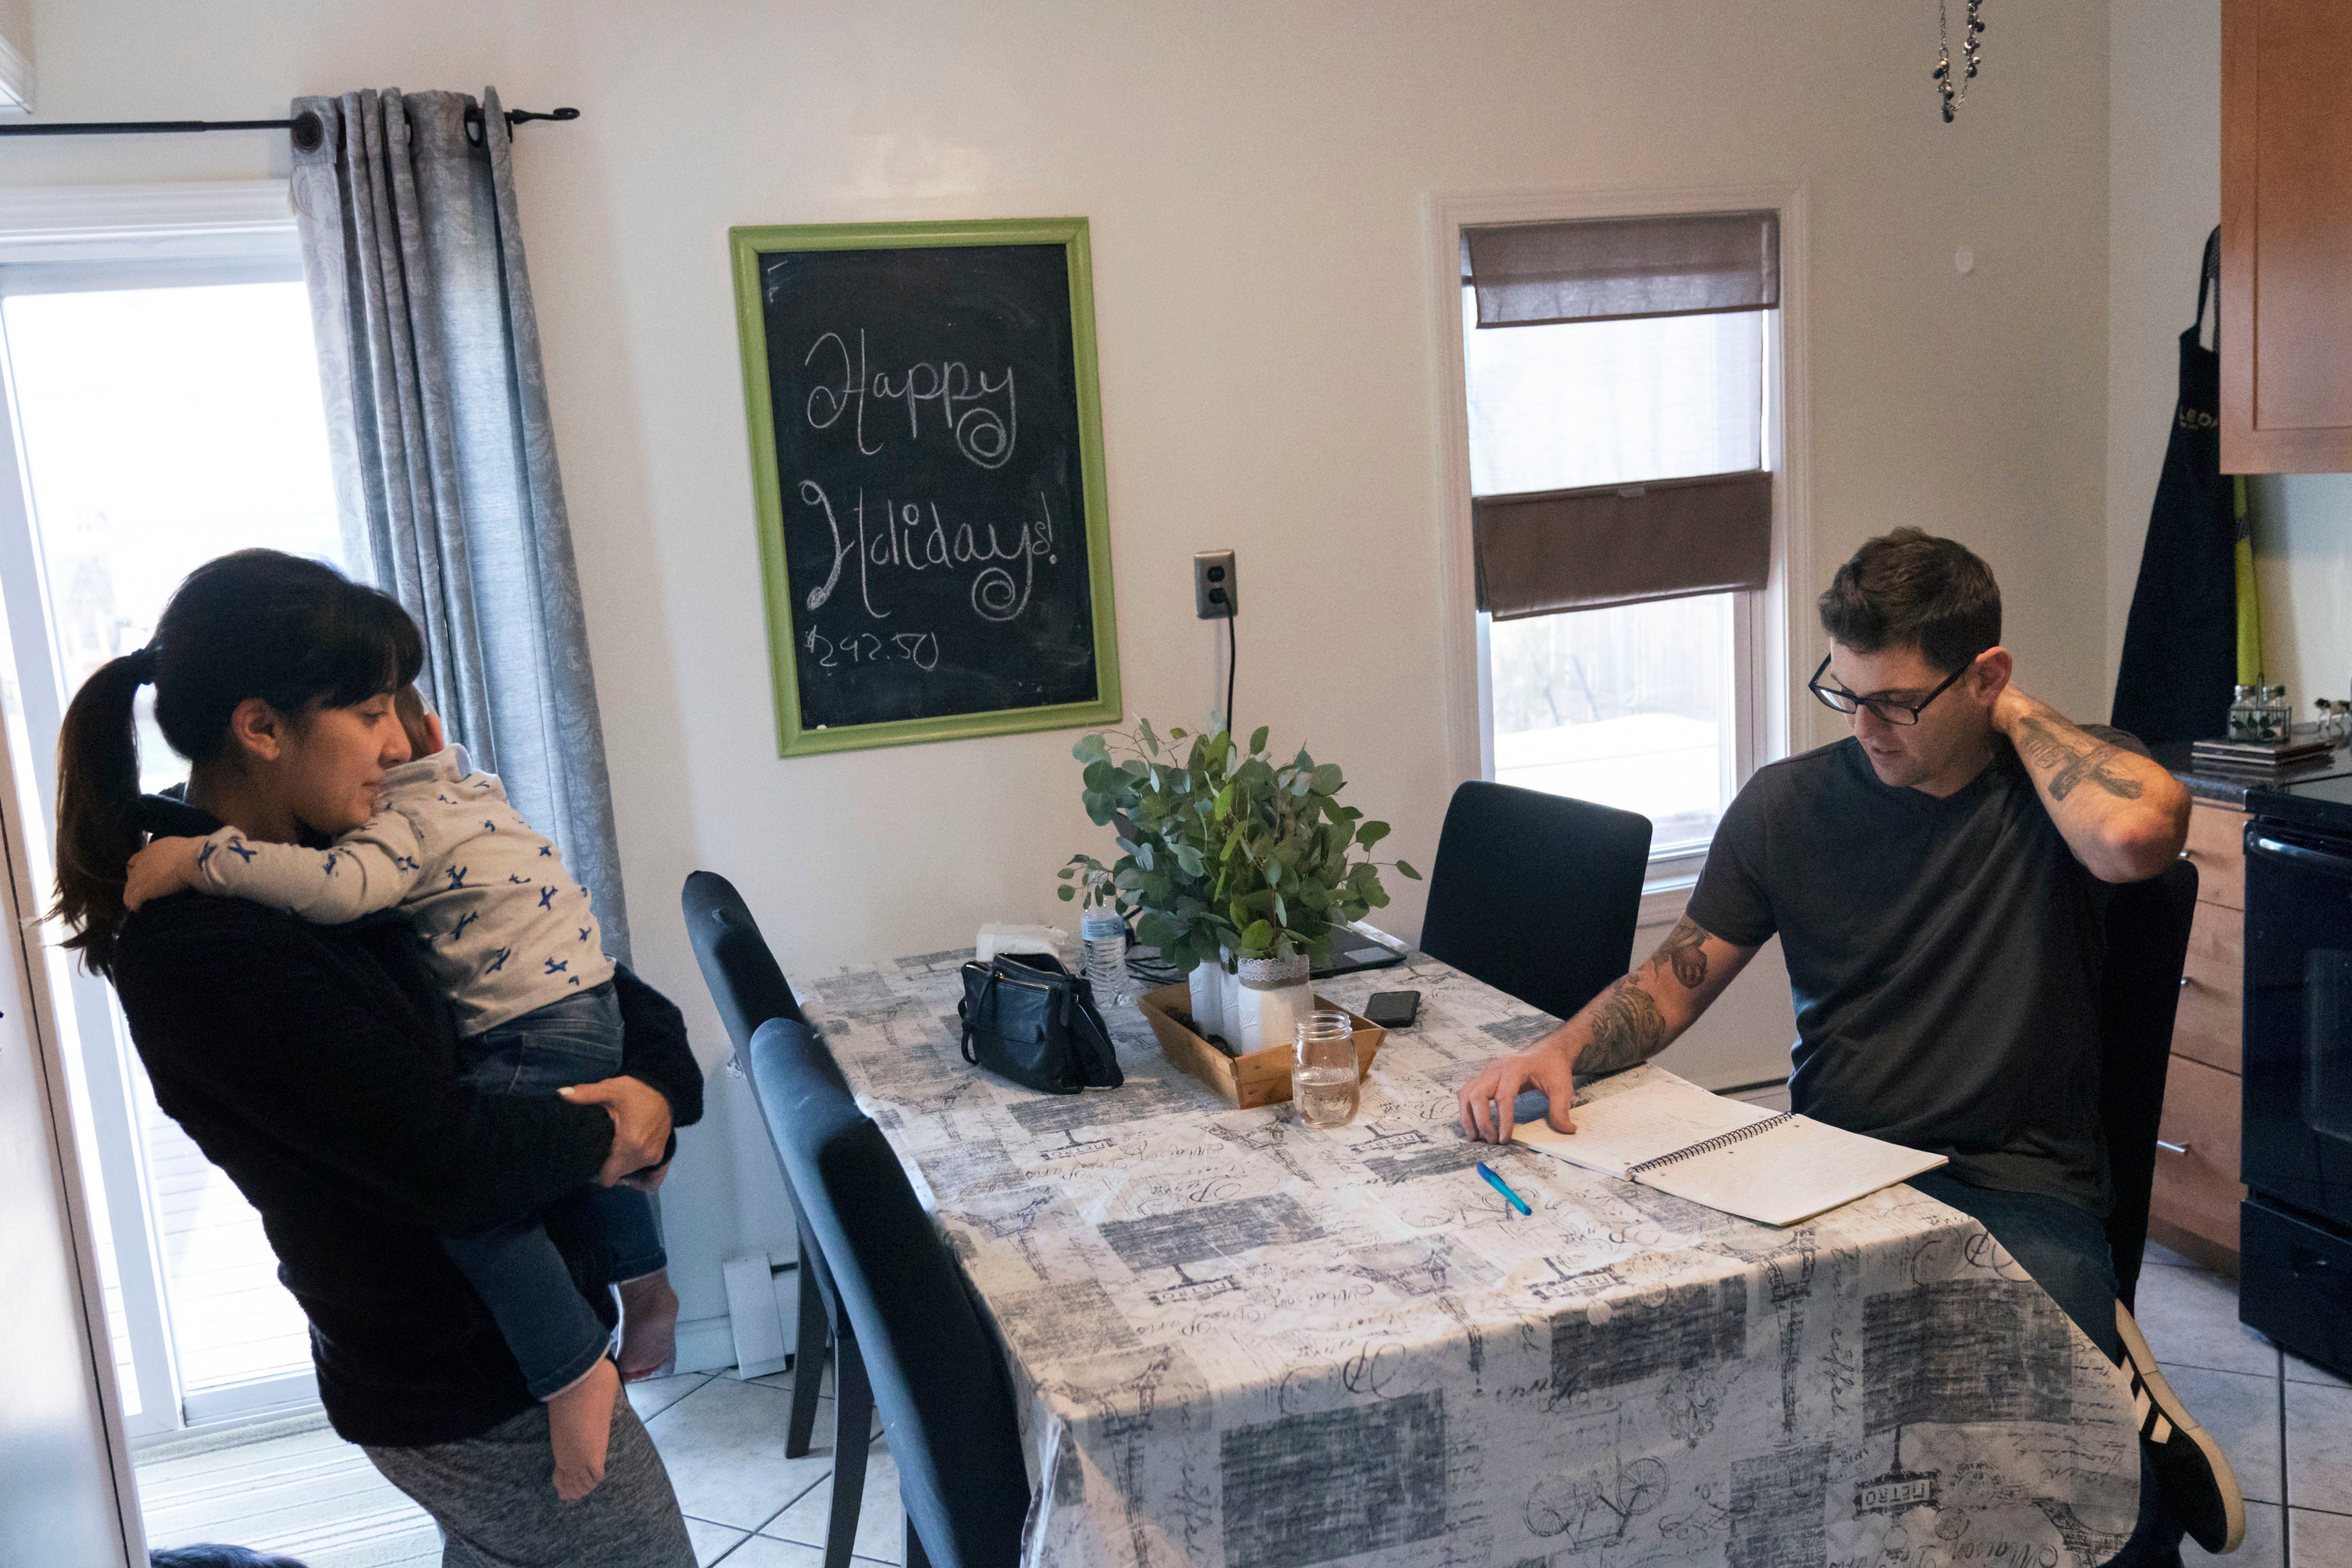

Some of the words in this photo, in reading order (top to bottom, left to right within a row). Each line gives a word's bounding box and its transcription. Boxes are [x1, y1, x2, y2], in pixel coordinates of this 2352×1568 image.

[804, 328, 1018, 469] Happy
[798, 479, 1058, 622] Holidays!
[1051, 1142, 1106, 1157] METRO
[1865, 1483, 1925, 1505] METRO
